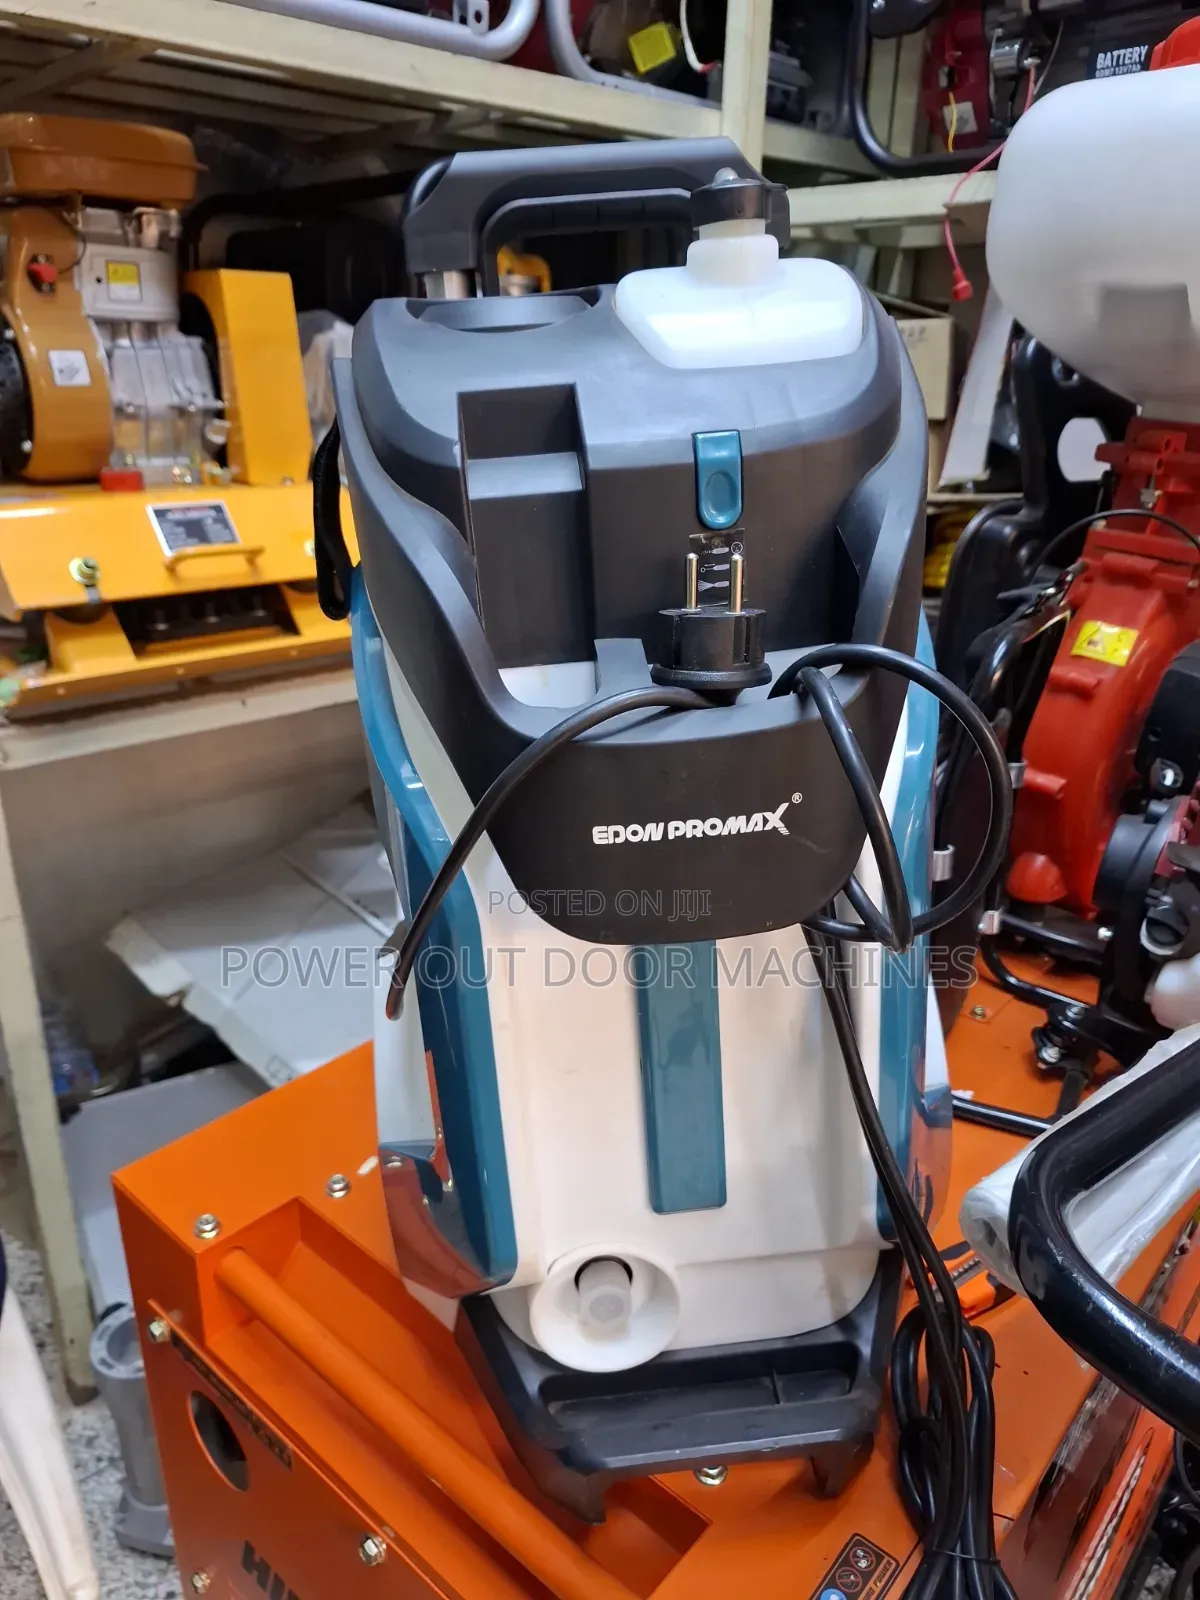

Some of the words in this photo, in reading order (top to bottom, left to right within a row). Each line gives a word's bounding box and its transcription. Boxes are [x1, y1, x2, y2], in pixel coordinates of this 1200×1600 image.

[1096, 45, 1149, 70] BATTERY
[592, 822, 664, 845] EDON
[667, 802, 790, 840] PROMAX
[242, 1539, 302, 1600] HI
[873, 1558, 893, 1588] POWER
